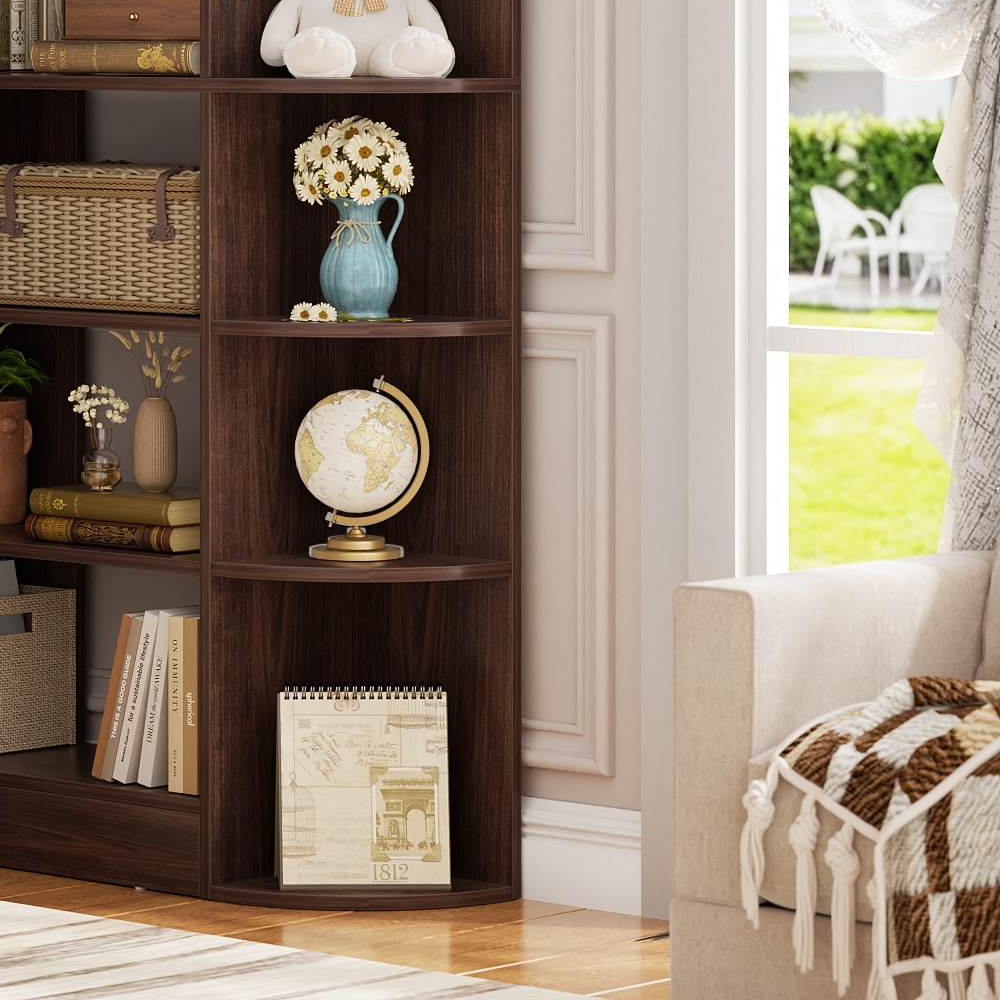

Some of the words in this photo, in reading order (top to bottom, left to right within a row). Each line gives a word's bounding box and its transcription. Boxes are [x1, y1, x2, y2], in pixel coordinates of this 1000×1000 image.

[132, 662, 144, 704] sustainable
[140, 633, 150, 661] lifestyle
[172, 639, 178, 652] ON
[110, 720, 119, 739] THIS
[118, 680, 126, 704] GOOD
[123, 654, 132, 679] GUIDE
[146, 712, 156, 743] DREAM
[154, 656, 163, 684] AWAKE
[185, 692, 196, 727] spherical
[373, 864, 408, 880] 1812
